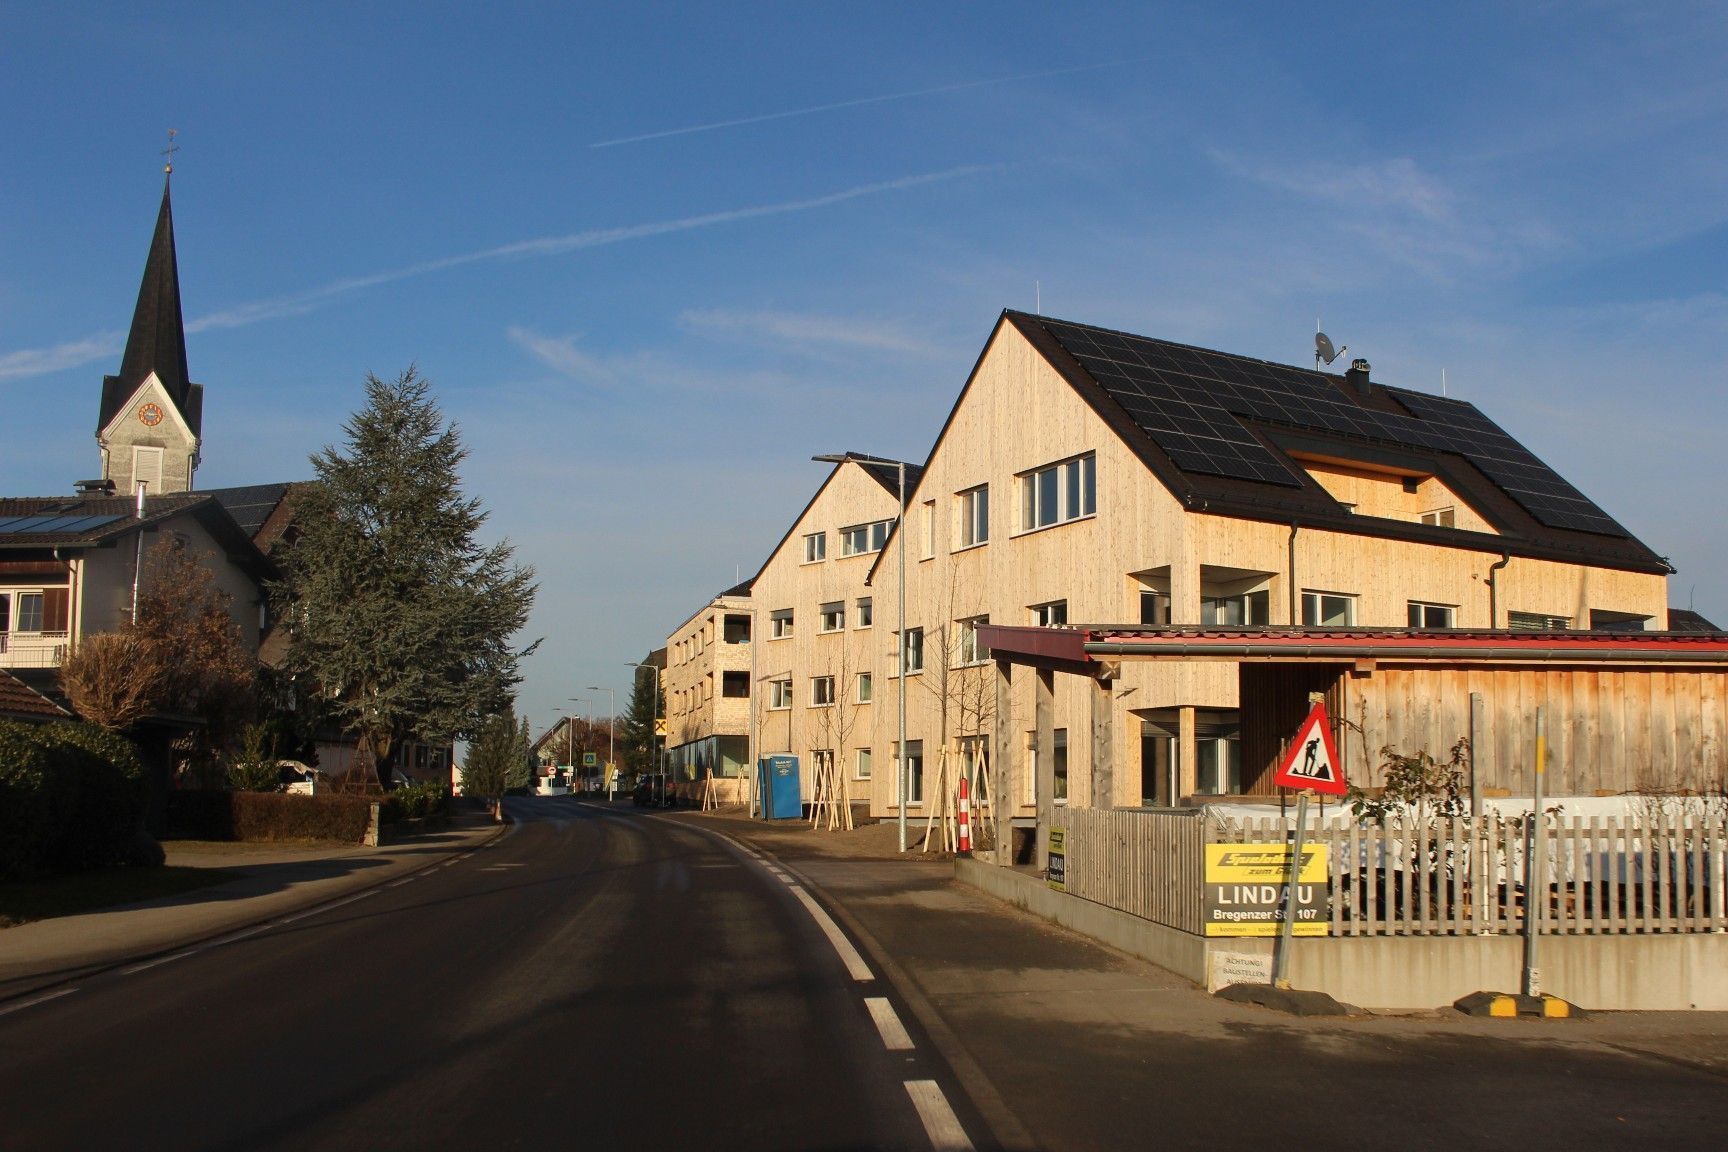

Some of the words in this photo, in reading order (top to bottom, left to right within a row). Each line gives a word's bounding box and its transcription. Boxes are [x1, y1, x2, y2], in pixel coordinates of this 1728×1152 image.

[1218, 885, 1313, 905] LINDAU
[1213, 909, 1273, 922] Bregenzer
[1296, 909, 1318, 920] 107
